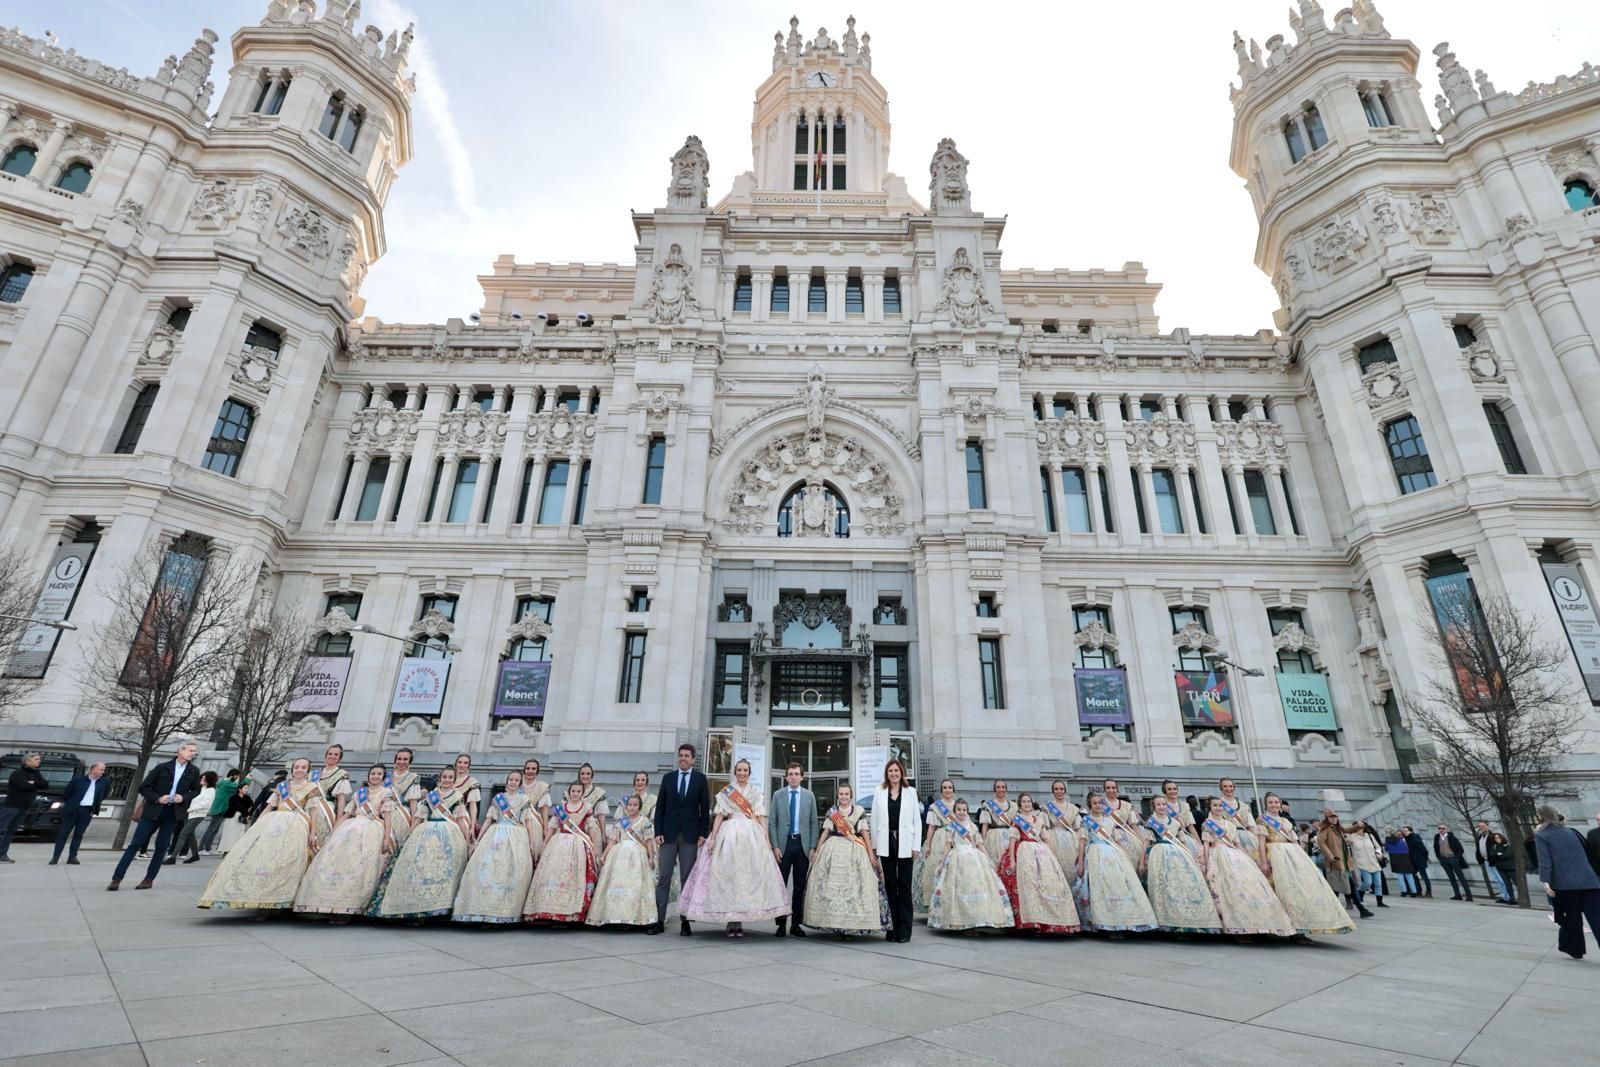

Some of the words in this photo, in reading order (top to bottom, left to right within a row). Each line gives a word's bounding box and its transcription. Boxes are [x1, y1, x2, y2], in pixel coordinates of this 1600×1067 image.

[48, 582, 75, 590] MADRID
[1560, 603, 1588, 611] MADRID
[300, 680, 340, 688] PALACIO
[303, 688, 338, 696] CIBELES
[505, 690, 539, 699] Monet
[1291, 689, 1314, 697] VIDA
[1085, 697, 1121, 707] Monet
[1285, 697, 1326, 706] PALACIO
[1292, 705, 1328, 713] CIBELES
